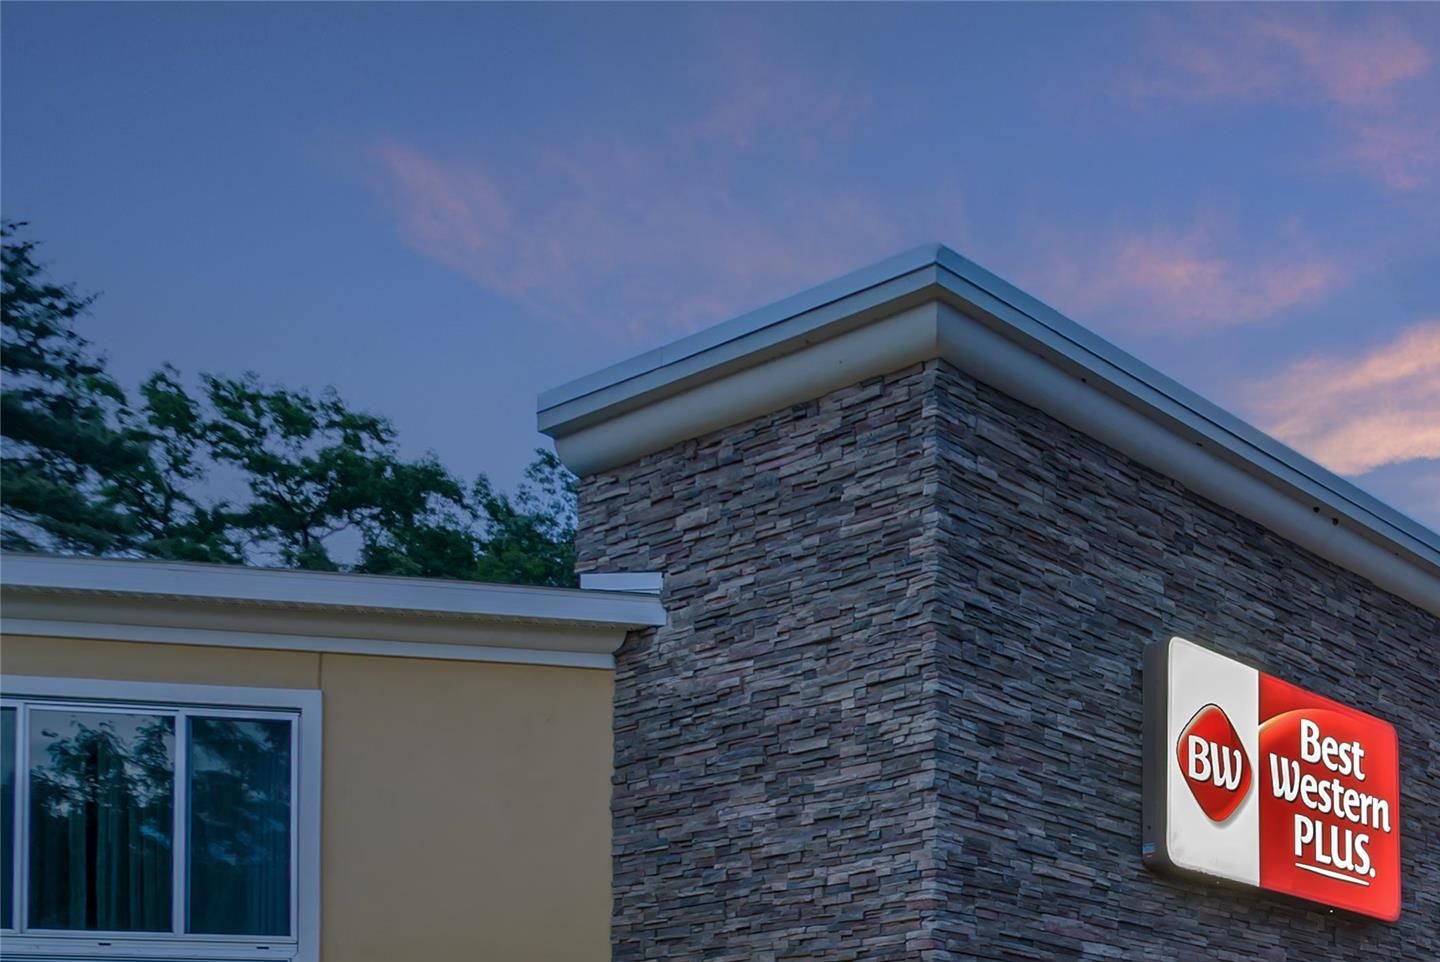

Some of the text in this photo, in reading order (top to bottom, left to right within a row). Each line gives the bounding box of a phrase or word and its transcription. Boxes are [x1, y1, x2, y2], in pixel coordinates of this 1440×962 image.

[1187, 734, 1243, 792] BW
[1300, 718, 1365, 781] Best
[1269, 753, 1391, 833] Western
